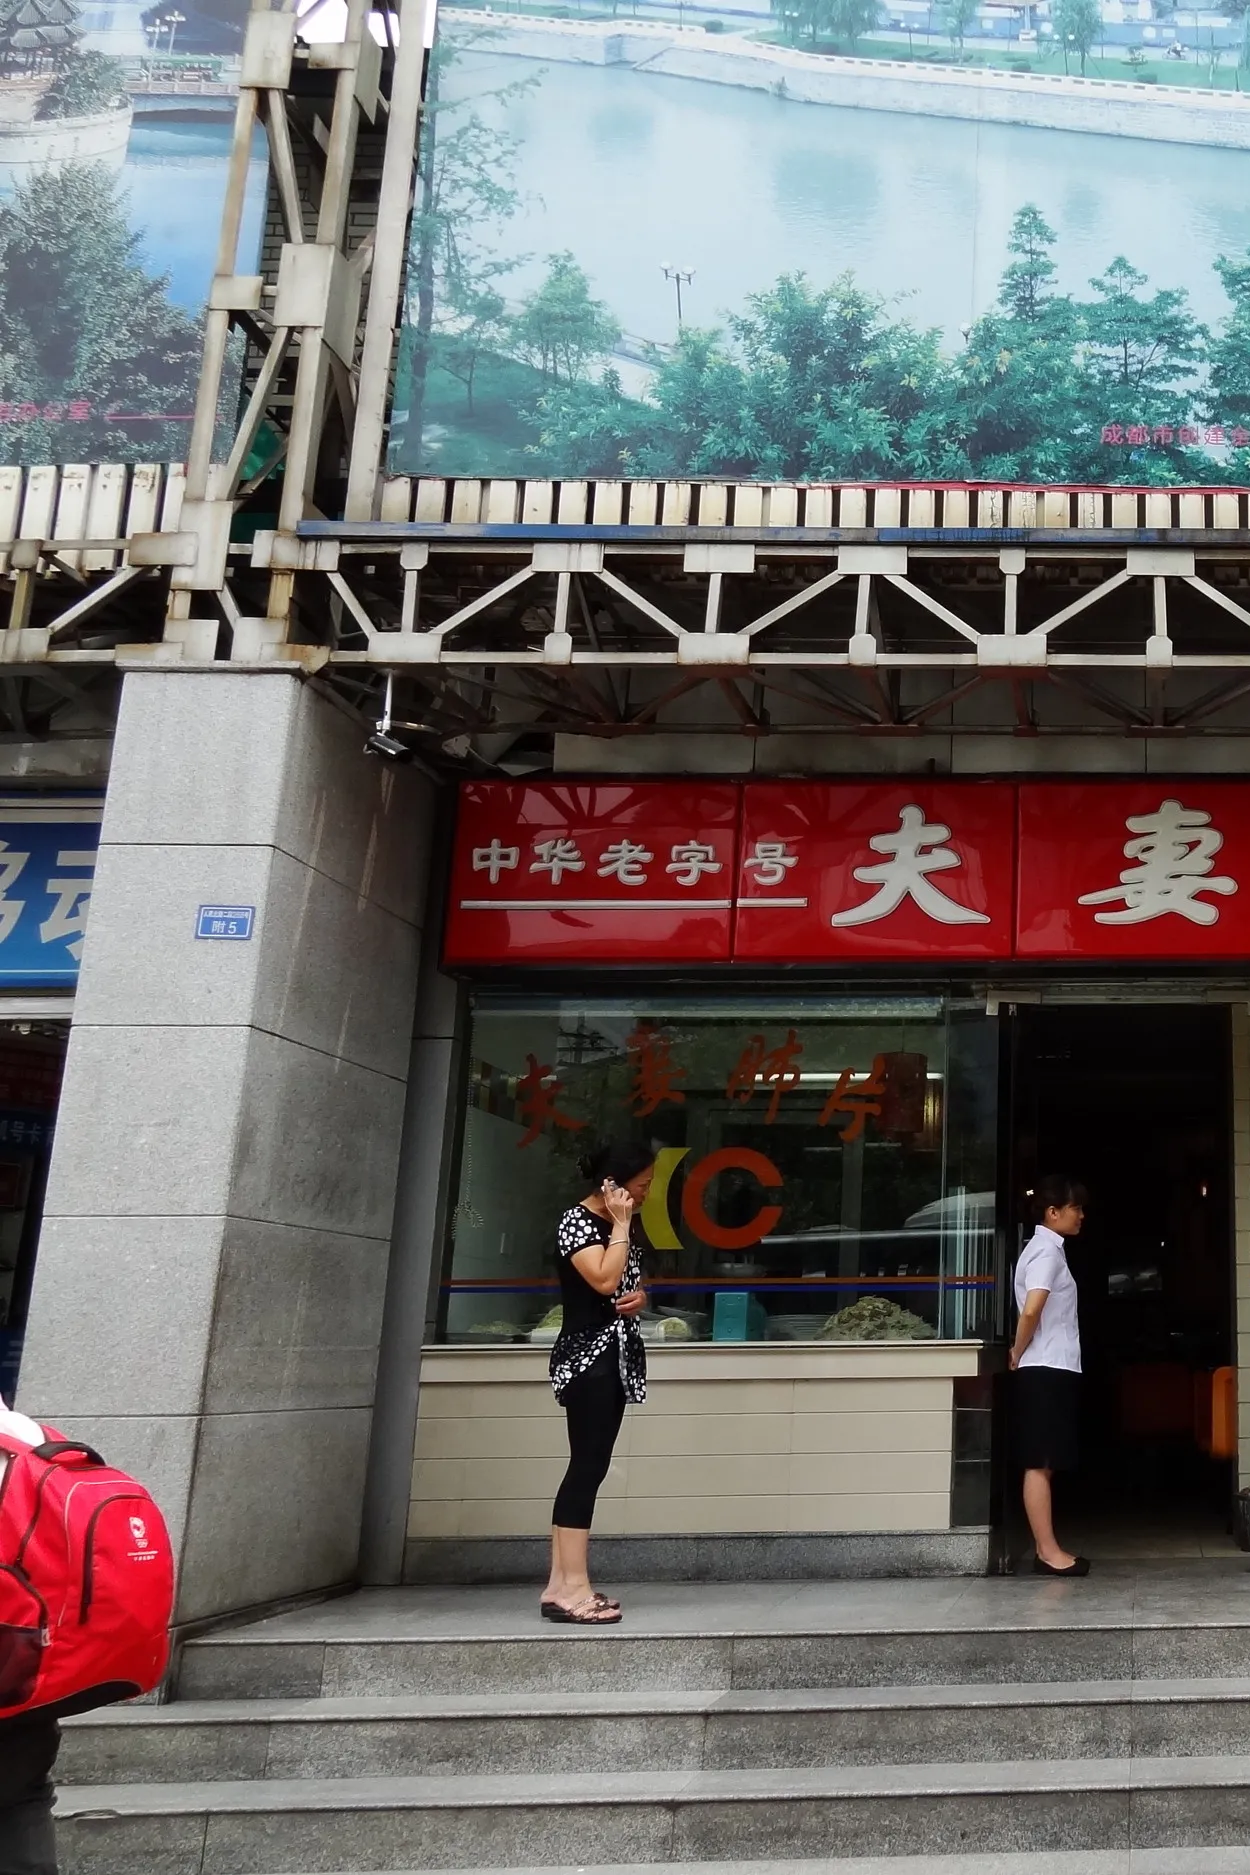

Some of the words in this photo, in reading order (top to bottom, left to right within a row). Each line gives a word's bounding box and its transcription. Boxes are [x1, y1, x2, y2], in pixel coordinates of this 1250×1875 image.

[472, 837, 798, 887] 中华老字号
